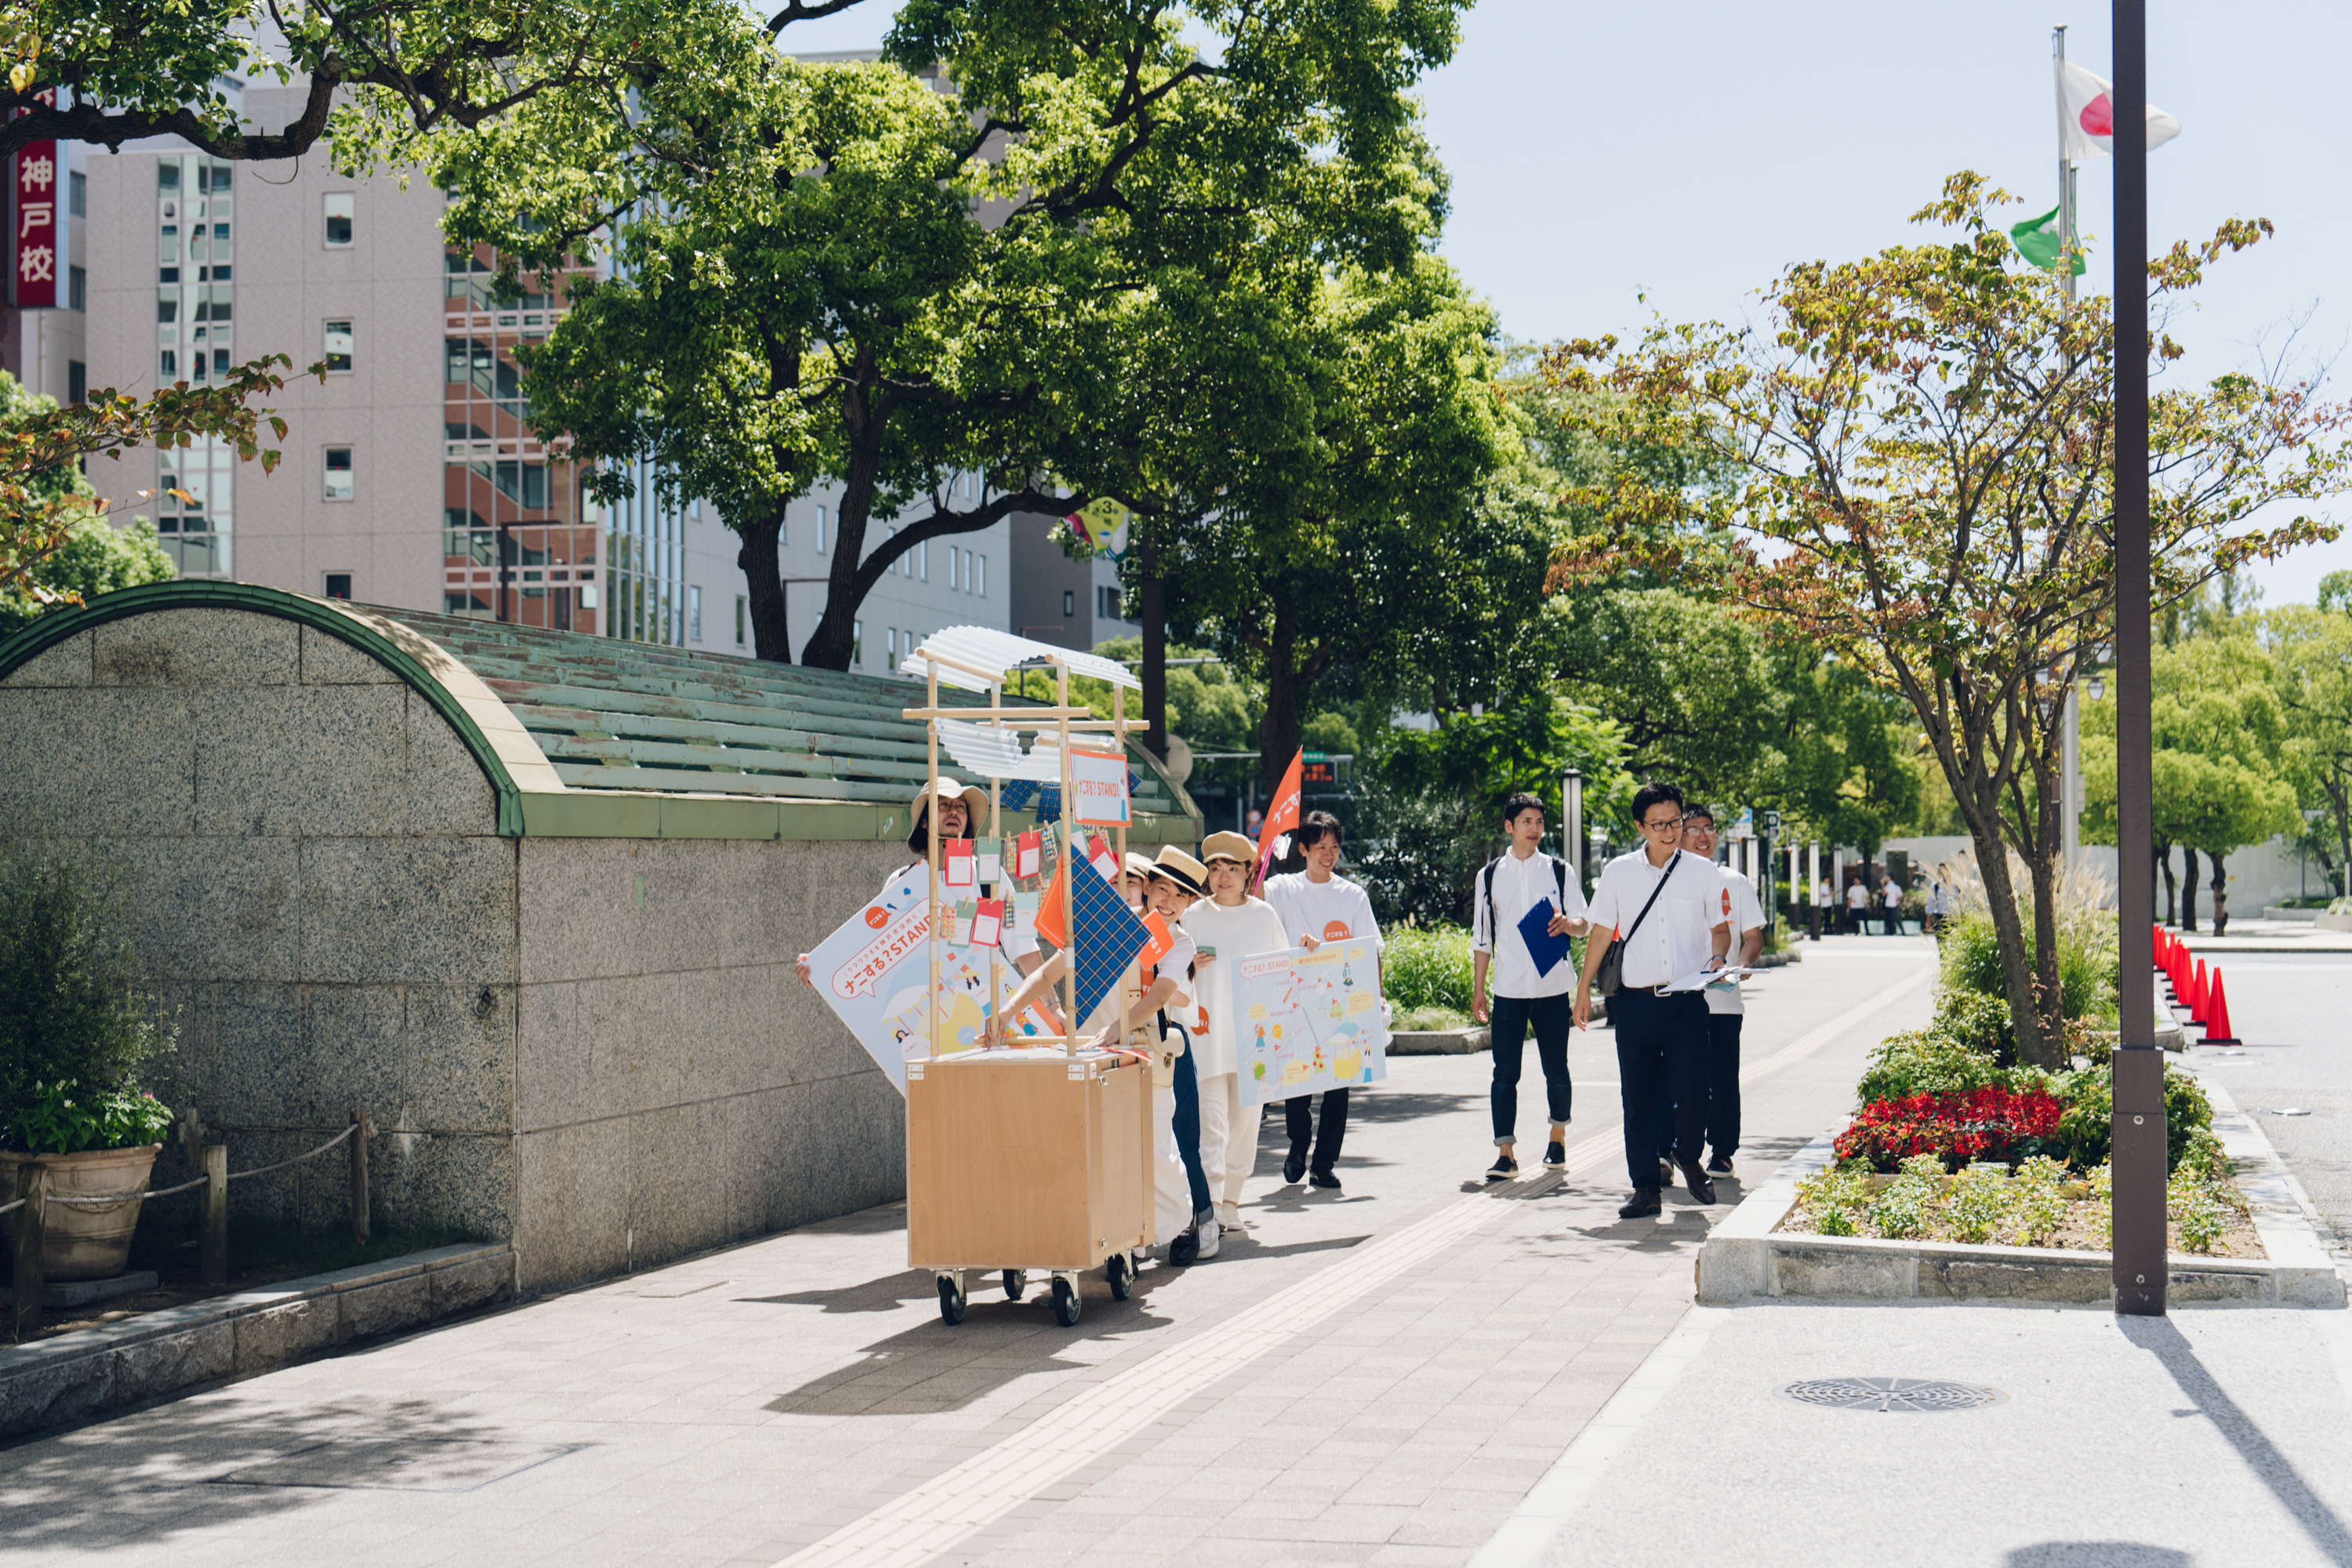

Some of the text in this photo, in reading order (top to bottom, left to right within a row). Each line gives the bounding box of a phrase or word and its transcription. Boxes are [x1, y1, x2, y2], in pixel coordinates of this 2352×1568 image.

[20, 154, 54, 283] 神戸校
[1098, 781, 1120, 797] STAND!
[1268, 959, 1290, 971] STAND!
